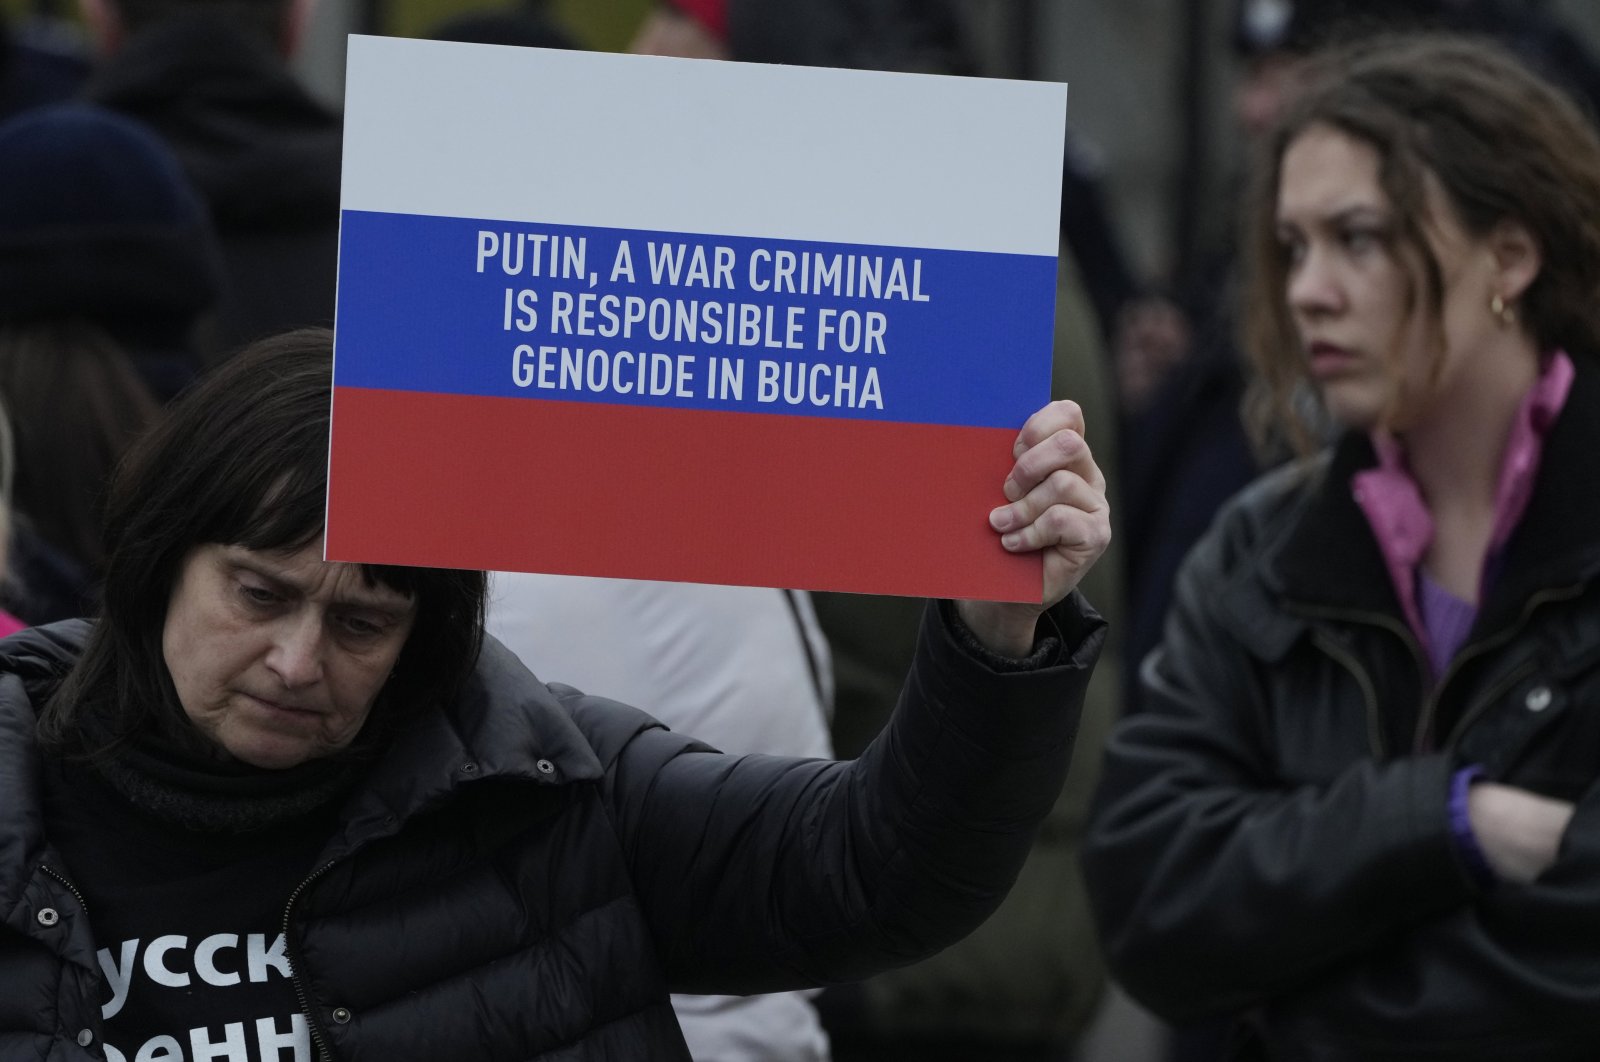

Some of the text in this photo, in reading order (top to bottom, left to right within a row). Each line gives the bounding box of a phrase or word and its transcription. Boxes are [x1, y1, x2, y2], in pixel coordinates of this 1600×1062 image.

[476, 230, 930, 303] PUTIN, A WAR CRIMINAL
[503, 287, 887, 355] IS RESPONSIBLE FOR
[511, 344, 884, 410] GENOCIDE IN BUCHA
